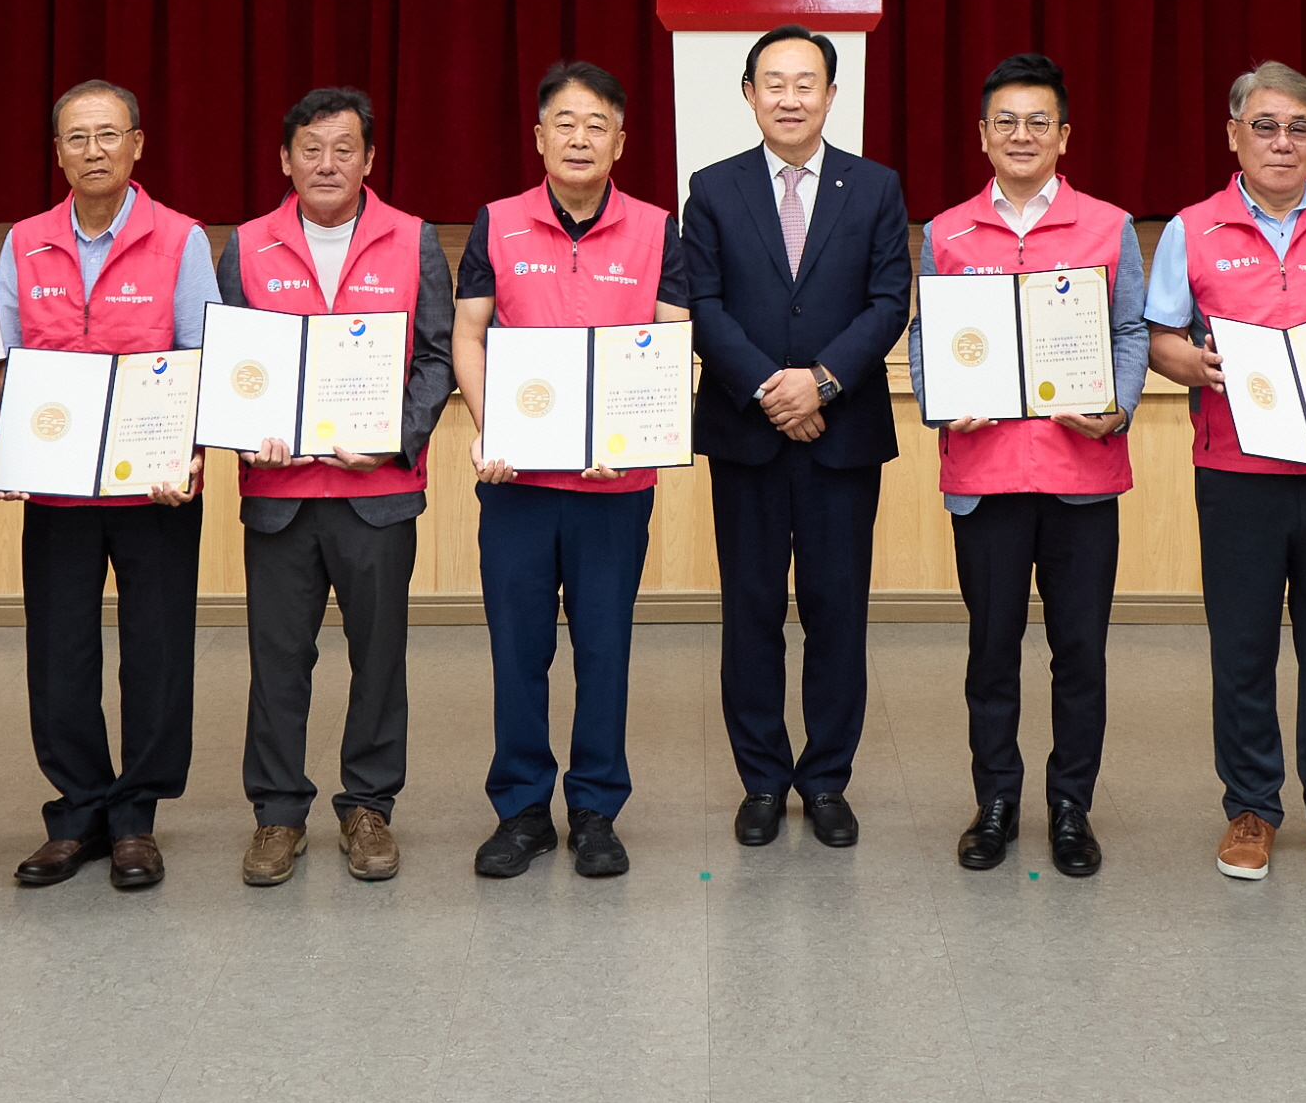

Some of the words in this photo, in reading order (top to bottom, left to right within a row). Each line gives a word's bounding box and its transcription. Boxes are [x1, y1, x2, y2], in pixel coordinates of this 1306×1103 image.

[1232, 256, 1260, 268] 통영시
[529, 263, 556, 274] 통영시
[282, 280, 310, 289] 통영시
